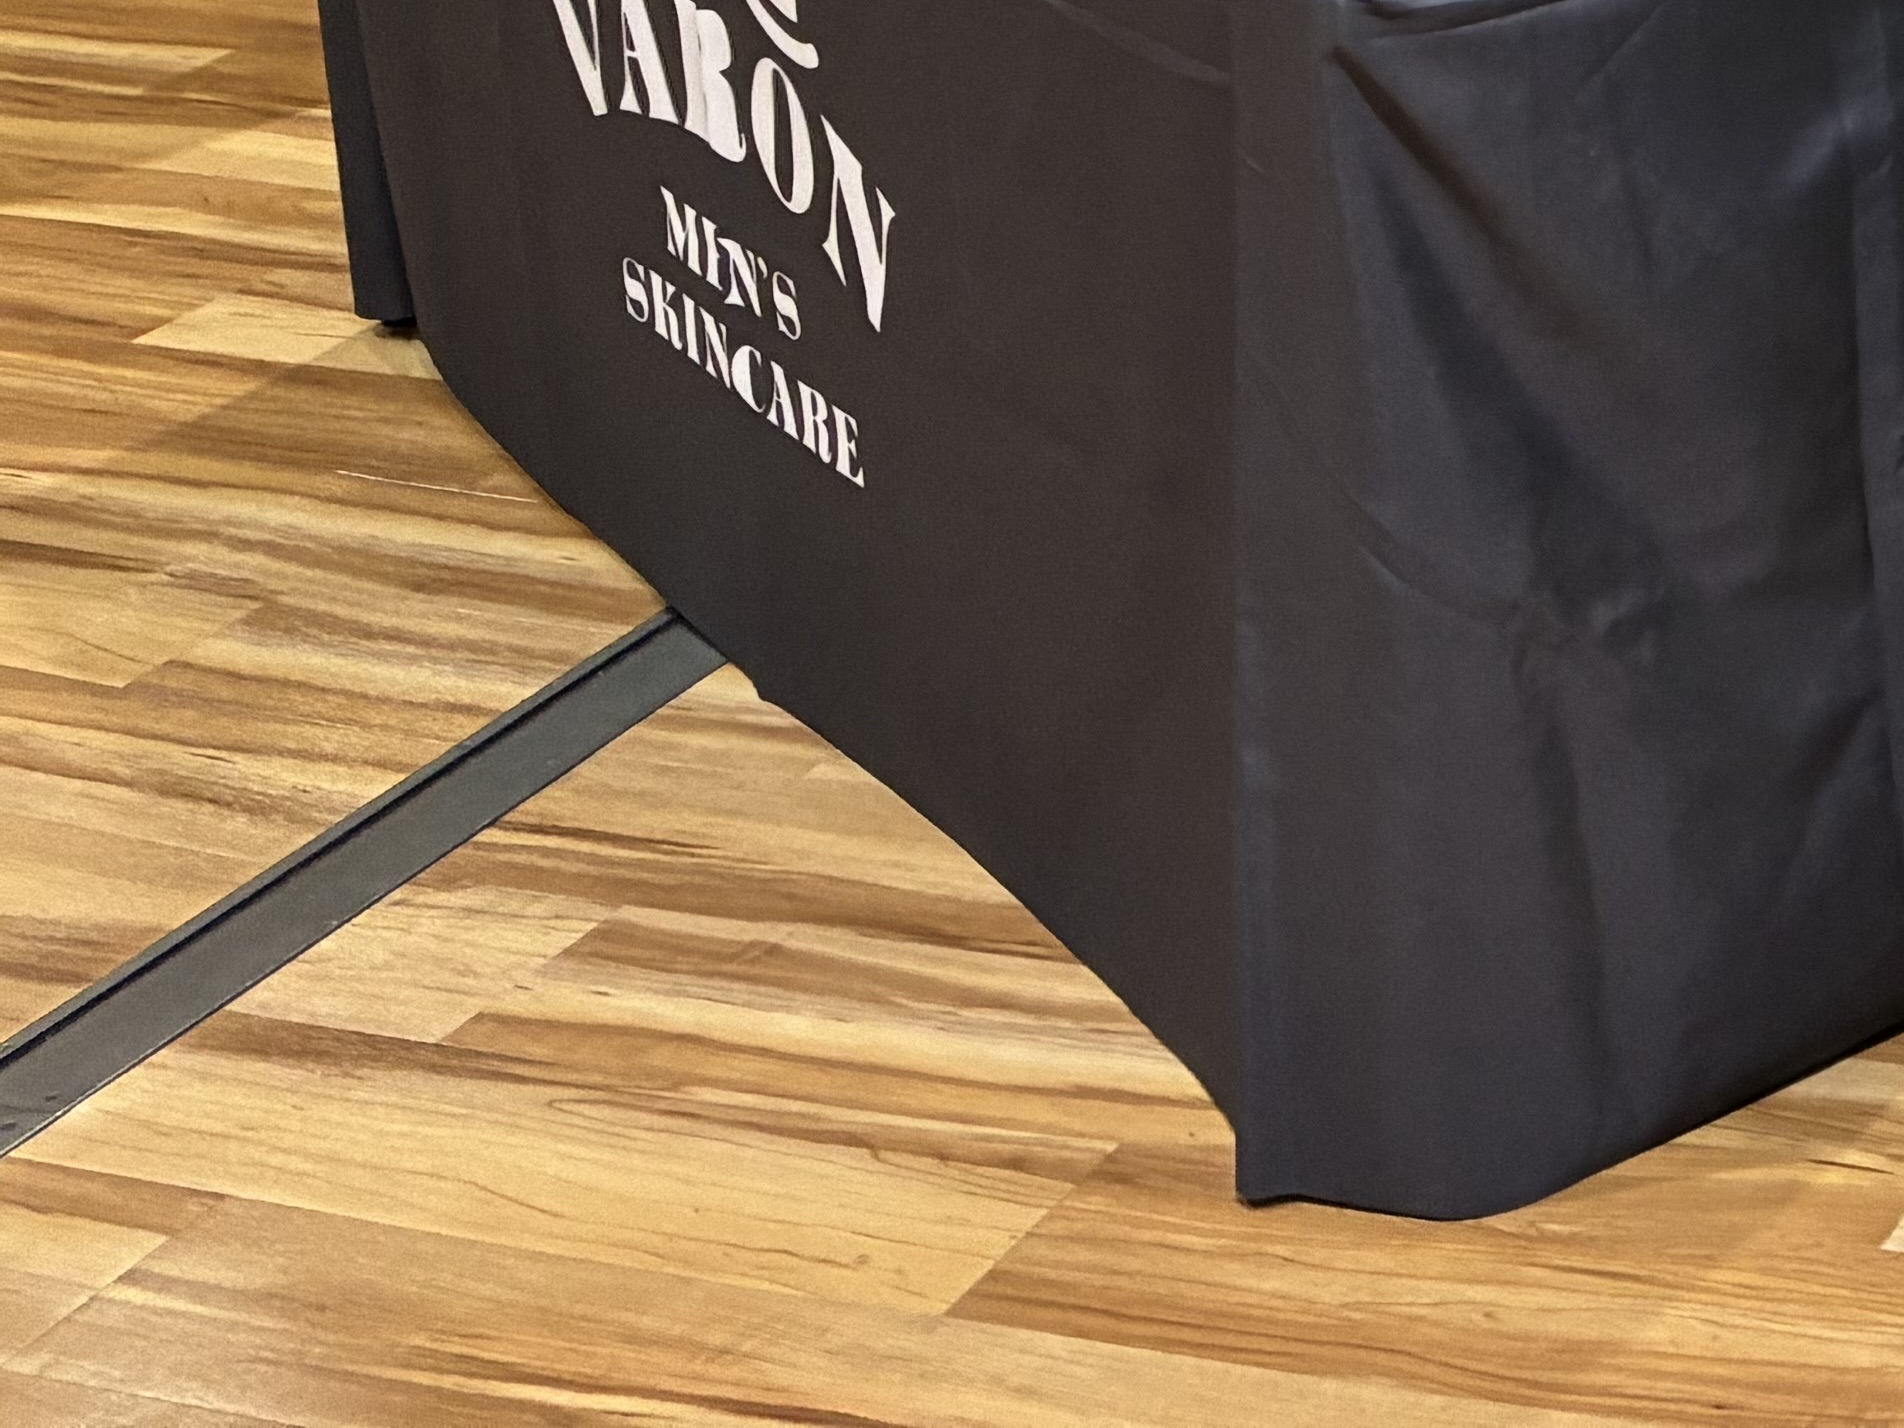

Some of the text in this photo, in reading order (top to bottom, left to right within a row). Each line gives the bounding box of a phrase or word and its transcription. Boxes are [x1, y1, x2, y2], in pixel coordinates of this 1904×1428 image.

[660, 185, 802, 342] MEN'S
[620, 255, 866, 489] SKIN CARE
